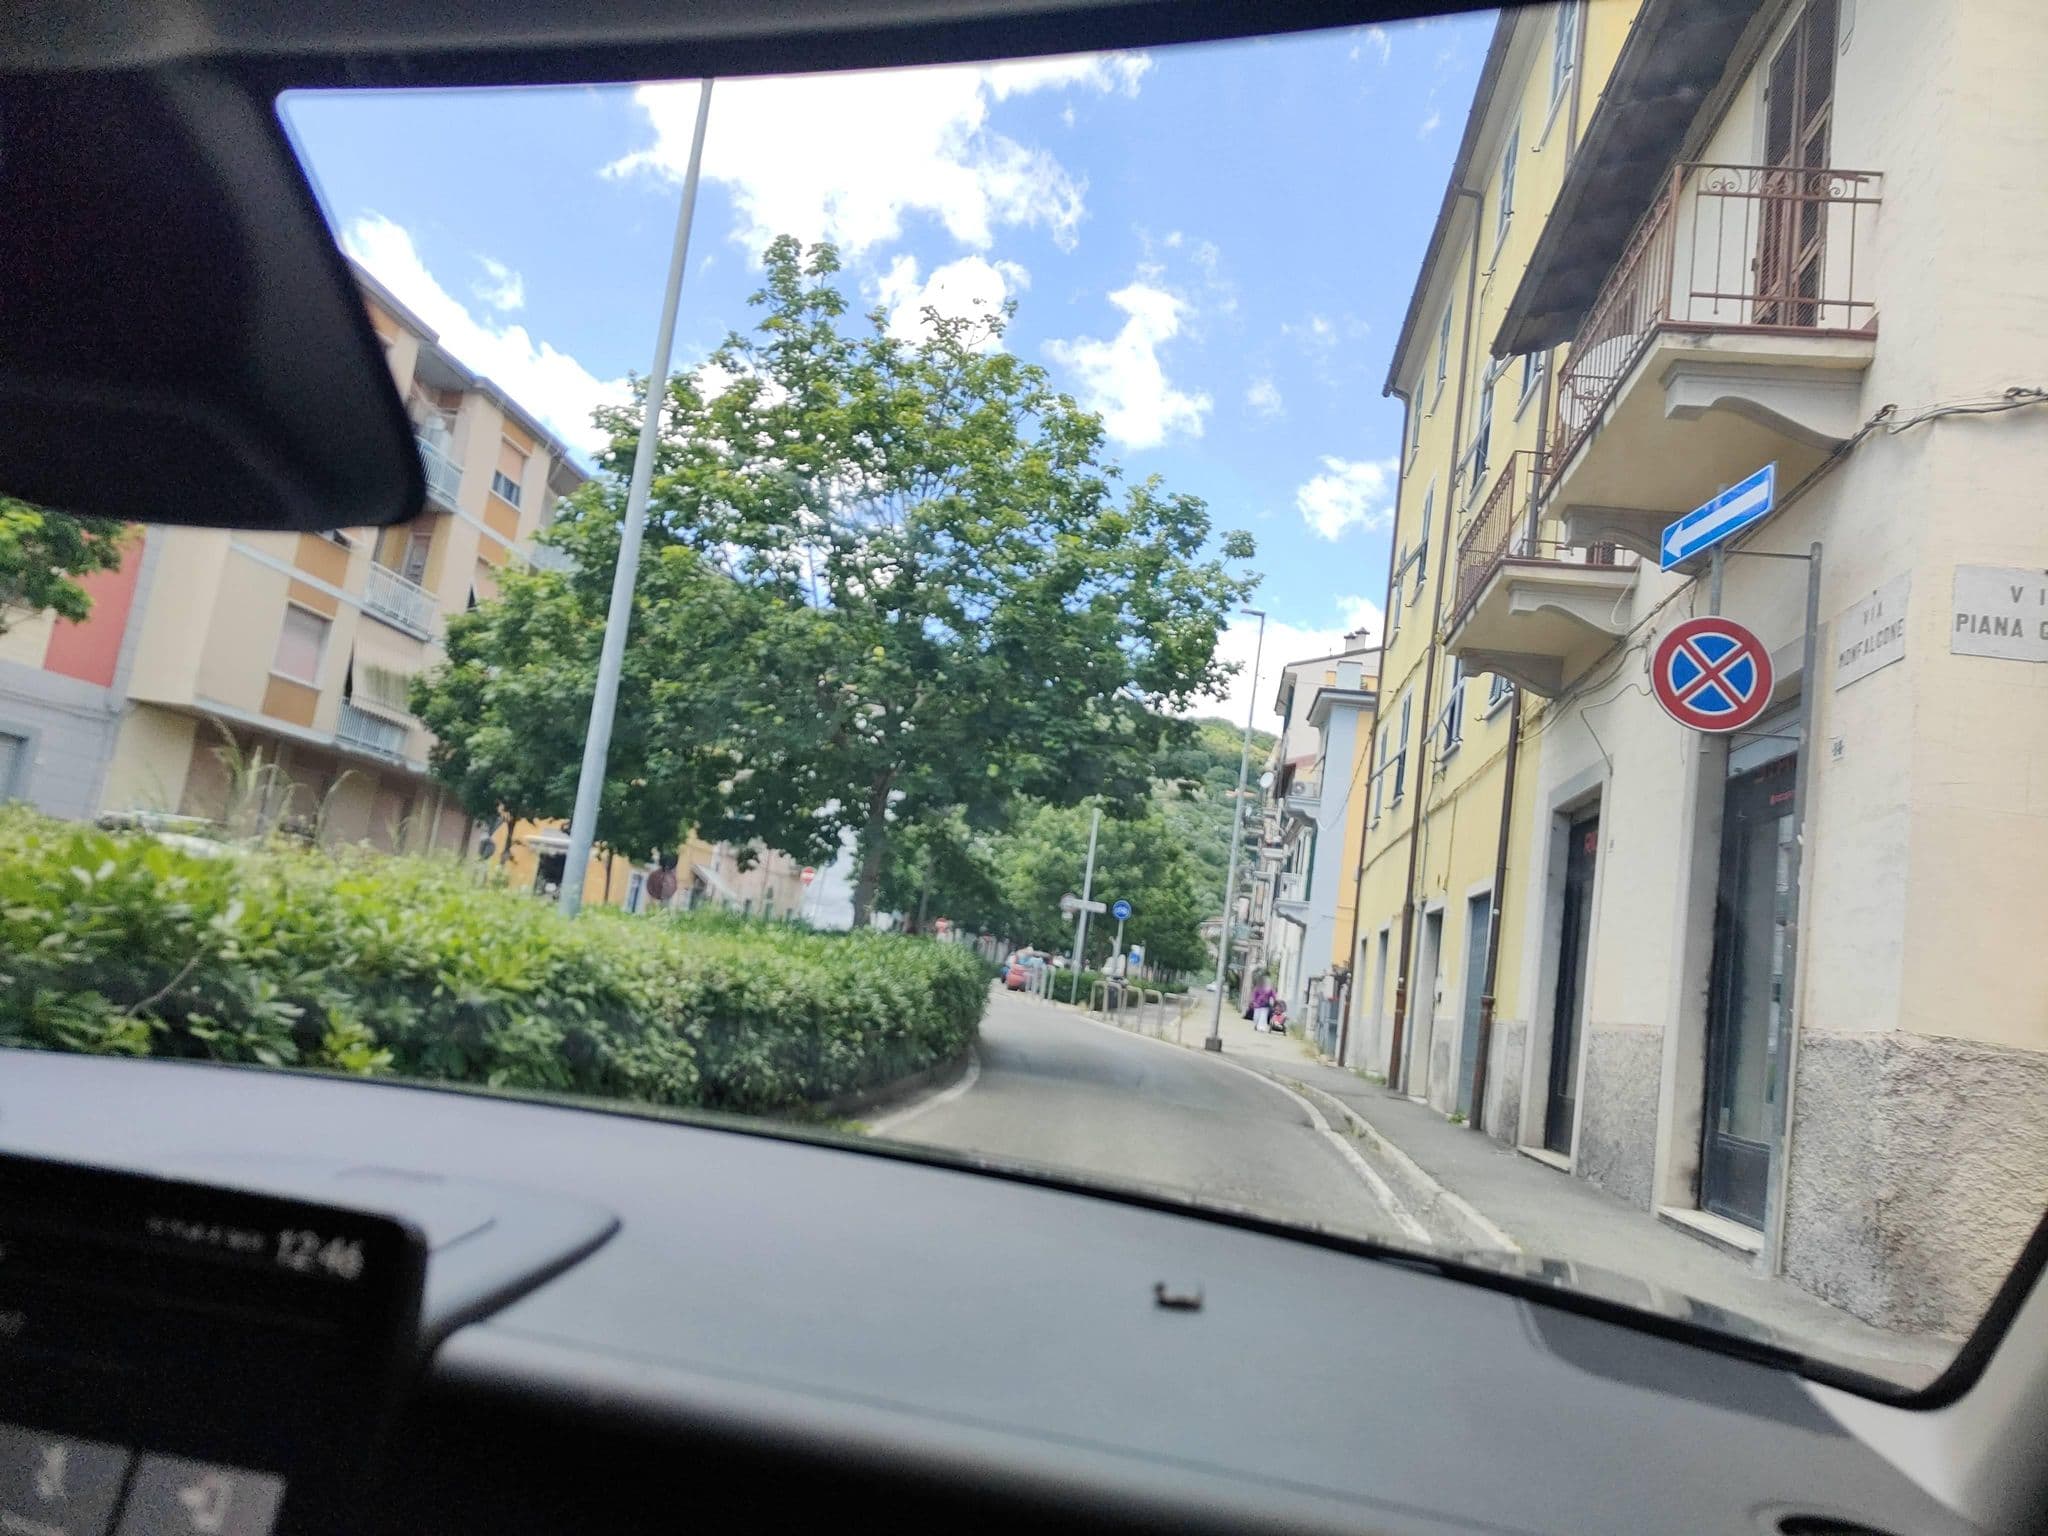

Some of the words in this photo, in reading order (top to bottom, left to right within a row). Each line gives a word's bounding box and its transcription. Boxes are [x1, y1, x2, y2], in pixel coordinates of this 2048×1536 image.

[1863, 601, 1884, 626] VIA
[1956, 612, 2024, 638] PIANA
[1838, 617, 1905, 668] MONFALCONE
